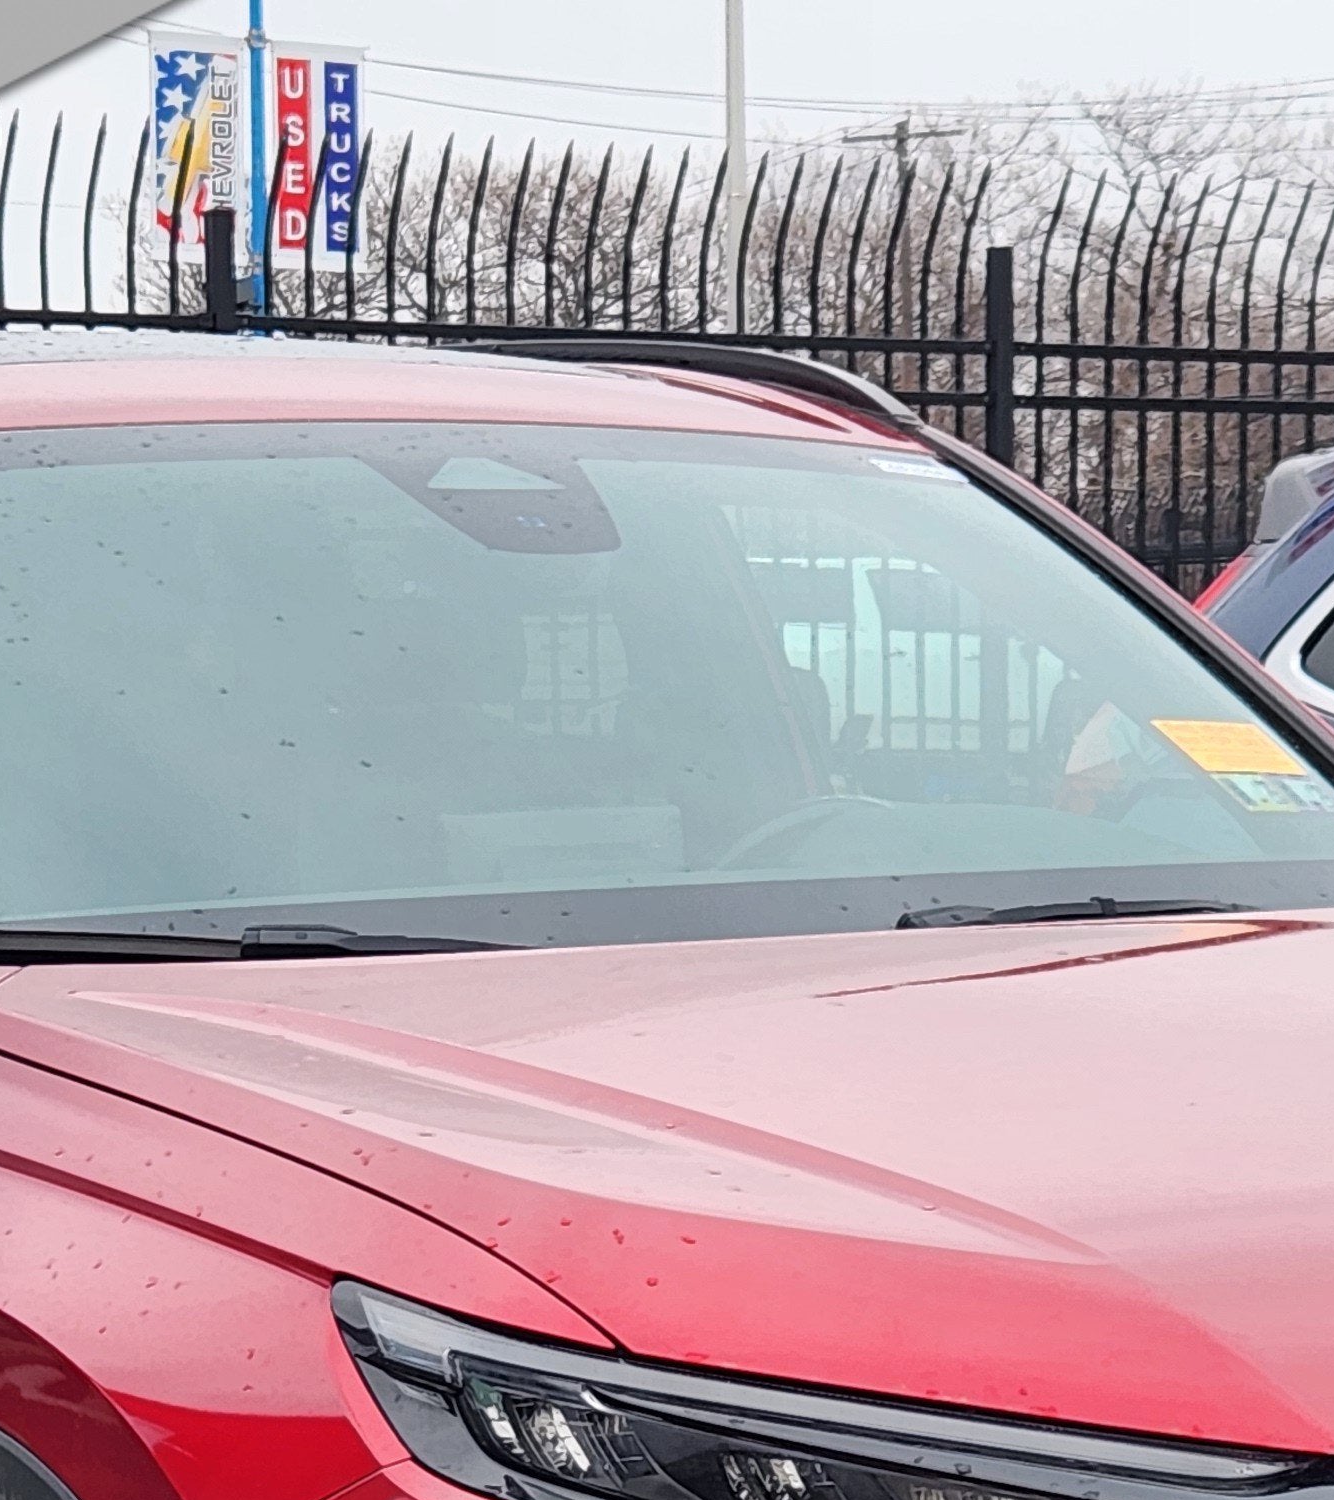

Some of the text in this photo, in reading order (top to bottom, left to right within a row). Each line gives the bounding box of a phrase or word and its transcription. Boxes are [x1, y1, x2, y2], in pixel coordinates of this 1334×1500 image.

[210, 65, 233, 209] HEVROLET
[283, 66, 307, 241] USED
[329, 72, 351, 242] TRUCKS
